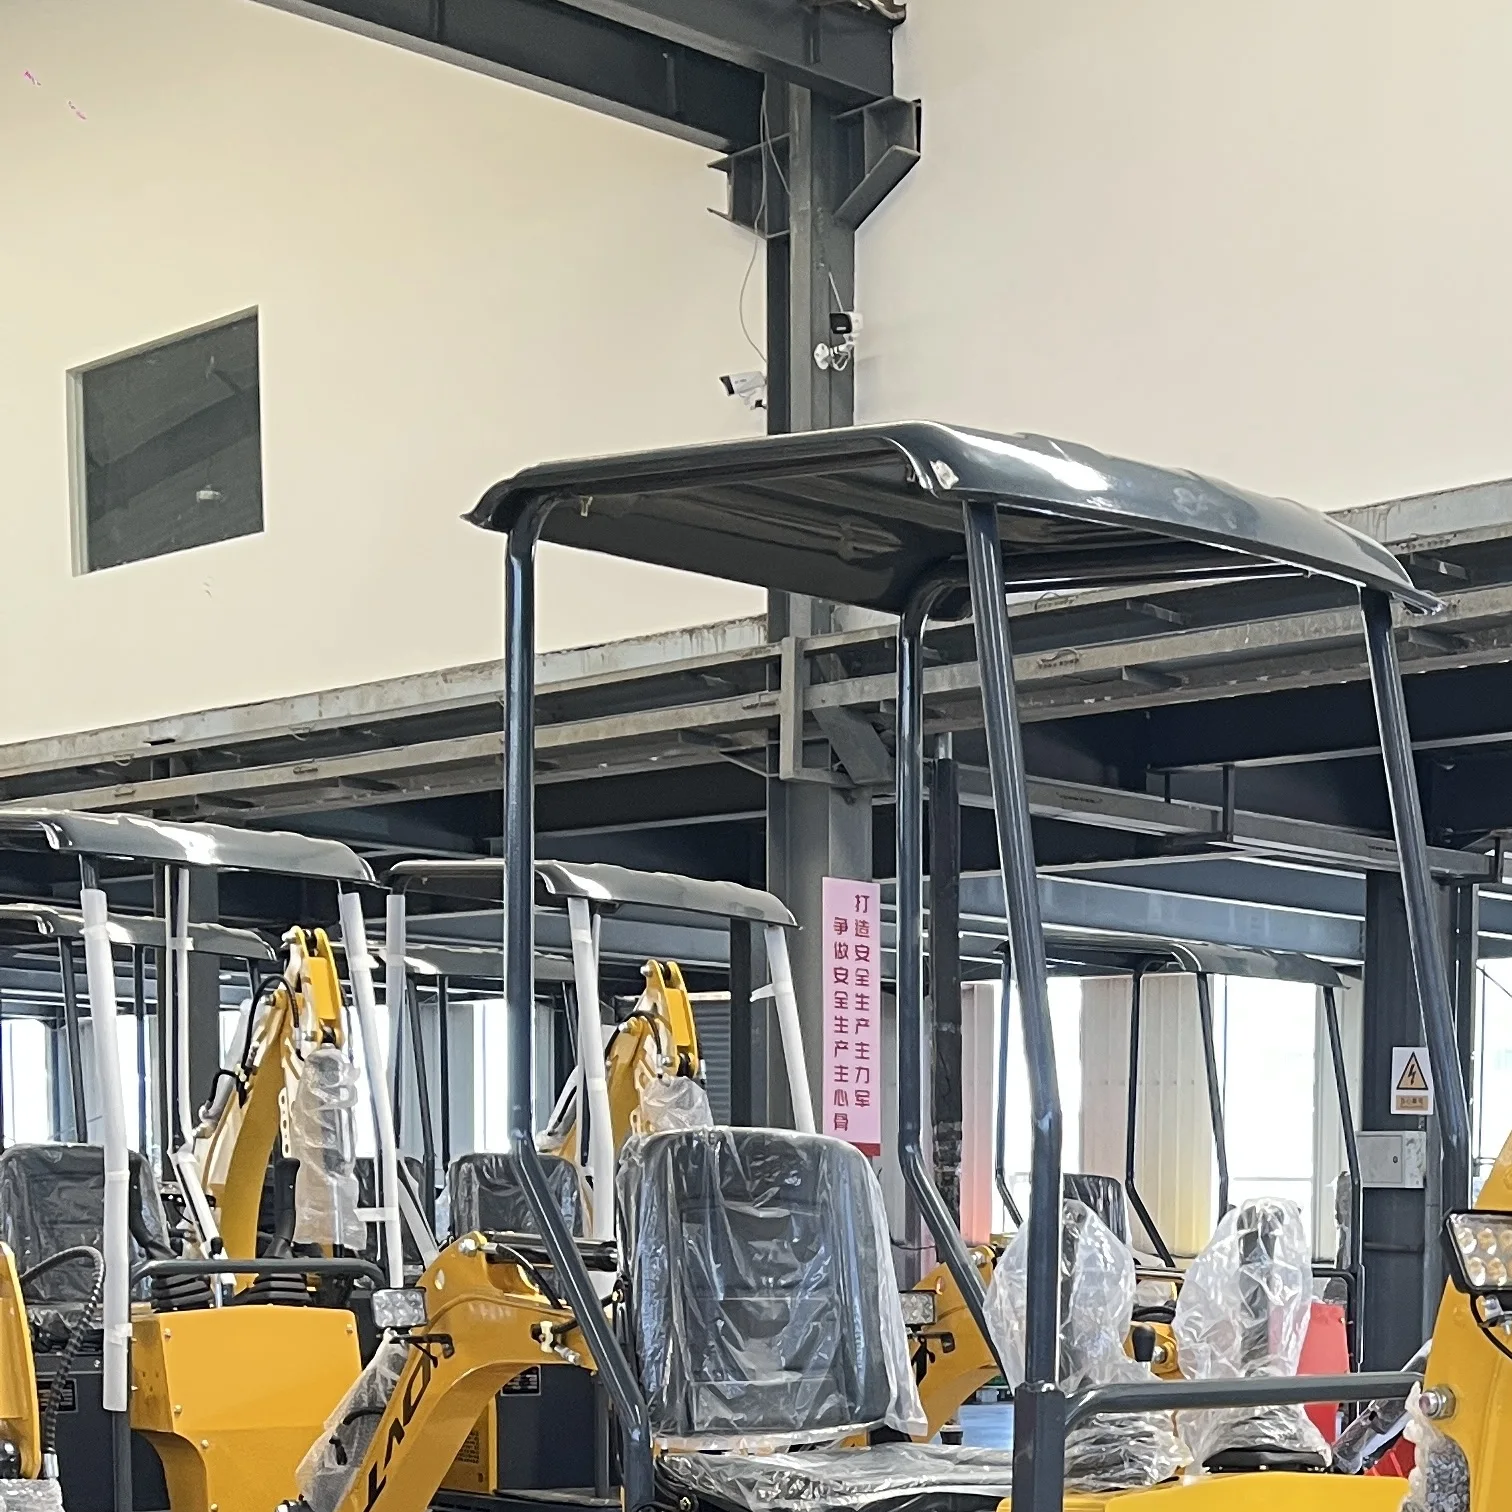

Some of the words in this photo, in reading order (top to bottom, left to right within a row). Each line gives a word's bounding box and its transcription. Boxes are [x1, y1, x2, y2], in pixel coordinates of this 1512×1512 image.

[833, 916, 849, 1132] 争做安全生产主心骨
[854, 894, 871, 1108] 打造安全生产主力军
